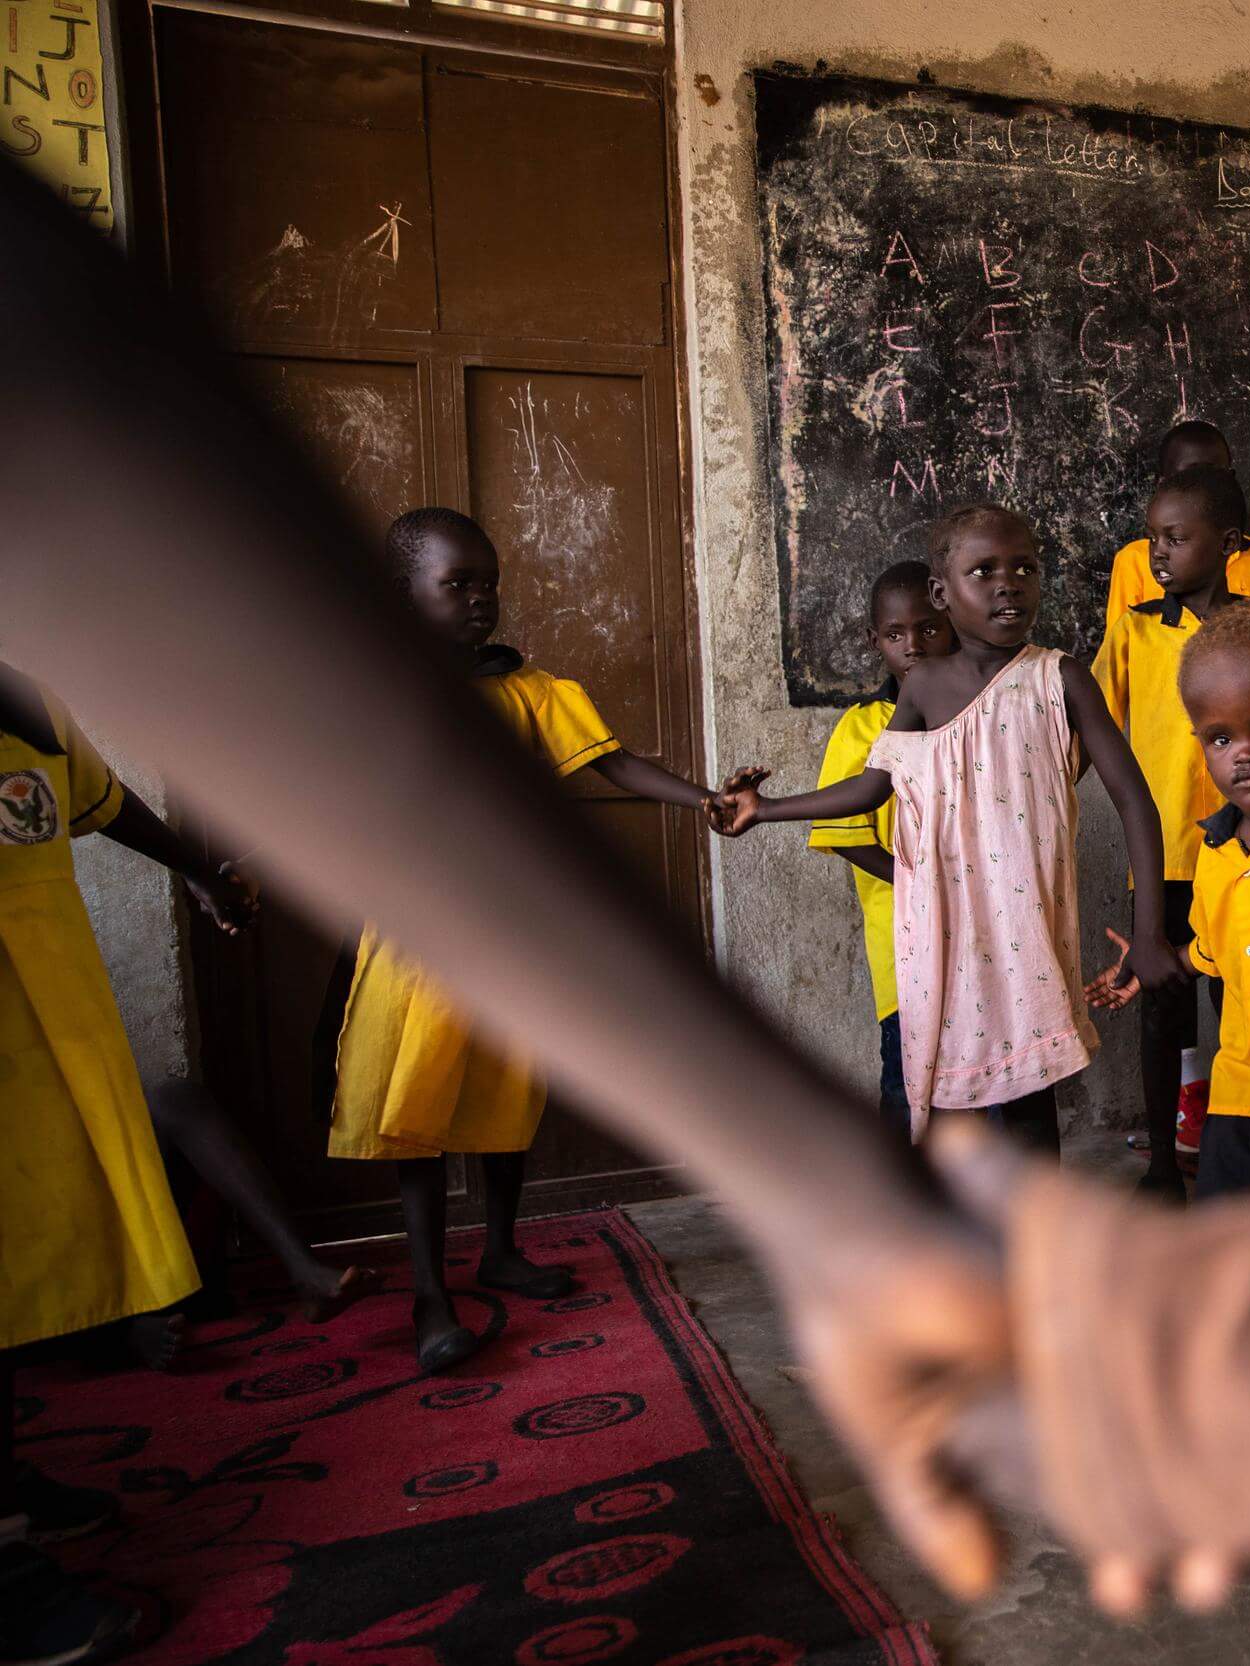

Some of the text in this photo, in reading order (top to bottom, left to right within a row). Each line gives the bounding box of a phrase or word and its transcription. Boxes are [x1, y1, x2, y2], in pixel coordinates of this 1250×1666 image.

[38, 14, 91, 60] J
[3, 63, 97, 110] N O
[0, 114, 104, 167] S T
[880, 230, 1179, 293] A B C D
[883, 303, 1193, 370] E F G H
[979, 382, 1020, 436] J
[890, 459, 943, 502] M
